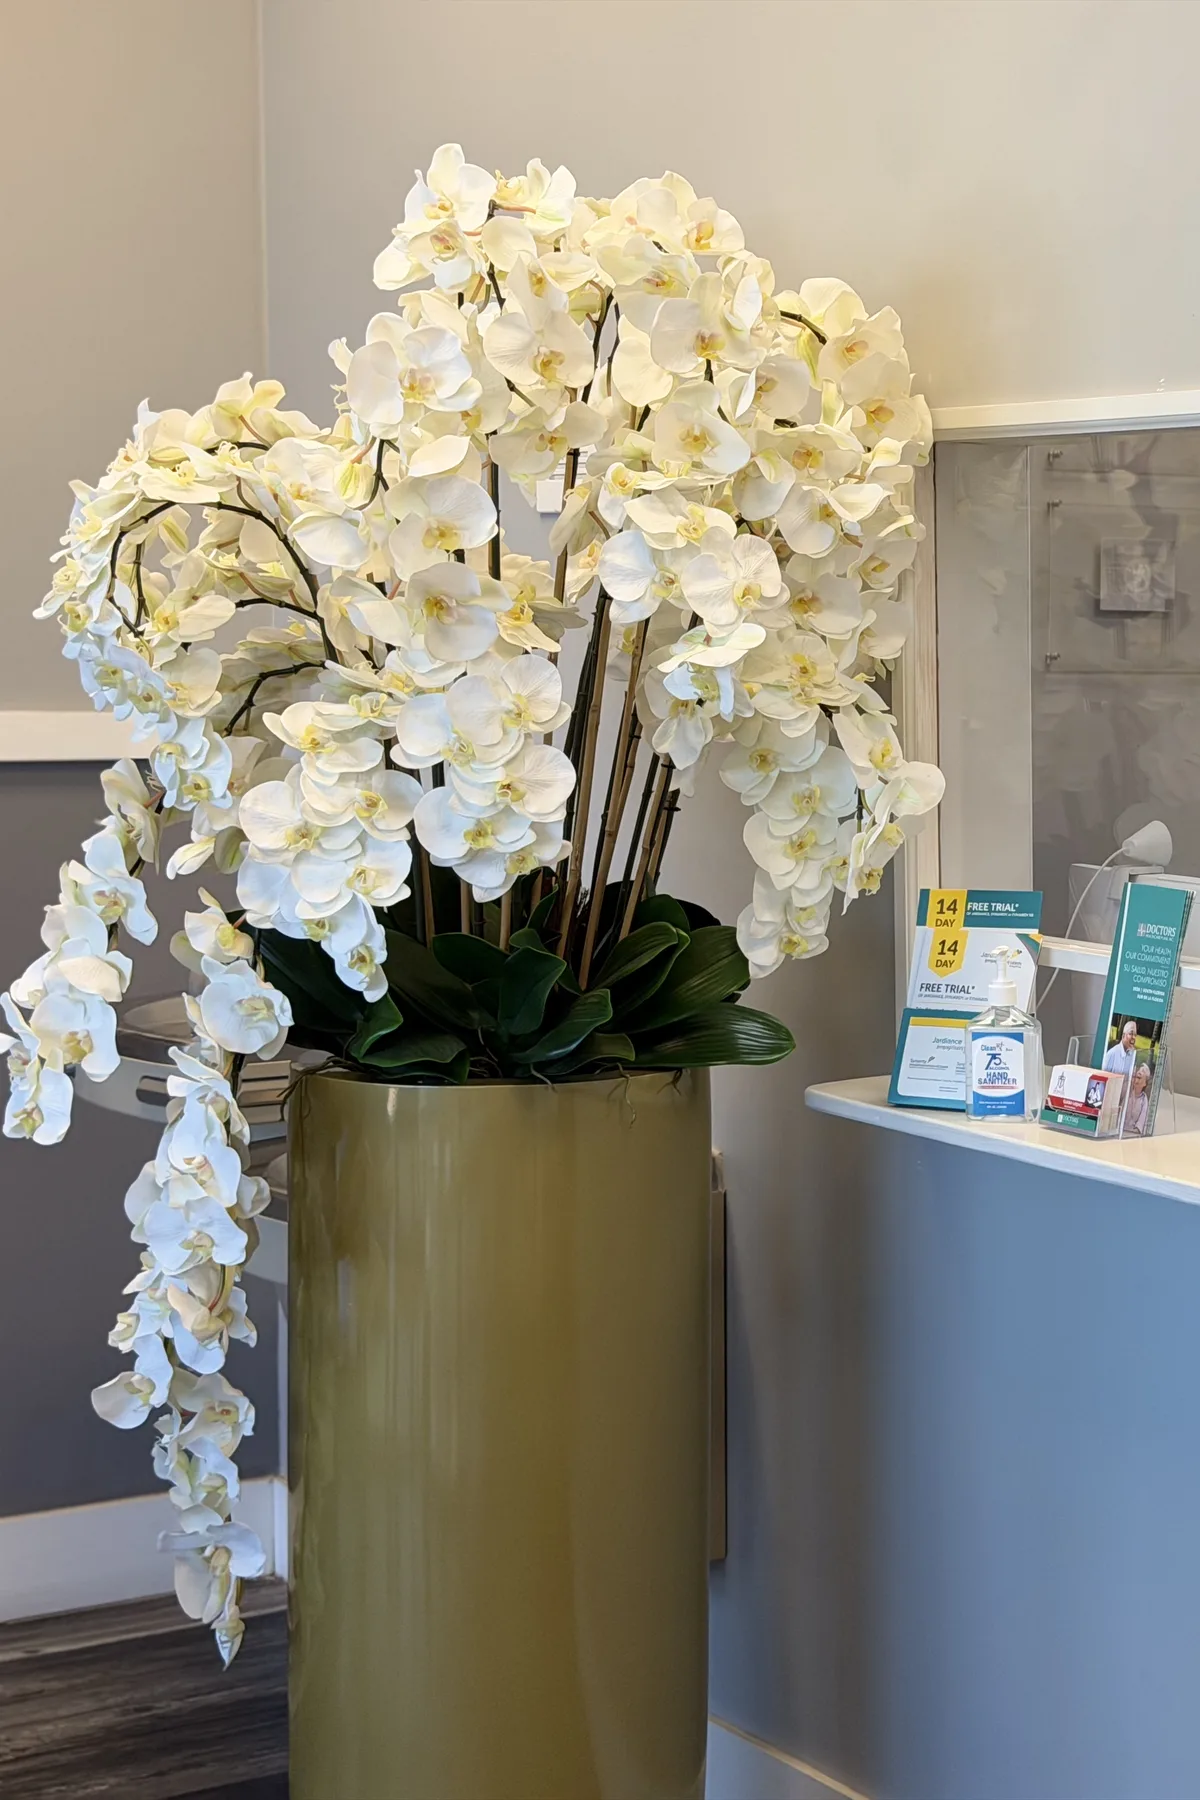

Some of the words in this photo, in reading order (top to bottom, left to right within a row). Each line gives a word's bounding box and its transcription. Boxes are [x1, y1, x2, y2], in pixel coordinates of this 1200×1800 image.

[936, 898, 958, 915] 14
[967, 902, 989, 911] FREE
[935, 918, 956, 927] DAY
[1147, 923, 1177, 937] DOCTORS
[937, 939, 959, 956] 14
[1141, 944, 1155, 953] YOUR
[1125, 950, 1137, 960] OUR
[1137, 952, 1171, 965] COMMITMENT
[935, 959, 956, 968] DAY
[1123, 963, 1131, 973] SU
[1147, 967, 1169, 979] NUESTRO
[1132, 974, 1167, 988] COMPROMISO
[919, 982, 944, 993] FREE
[932, 1037, 963, 1045] Jardiance
[986, 1071, 1009, 1079] HAND
